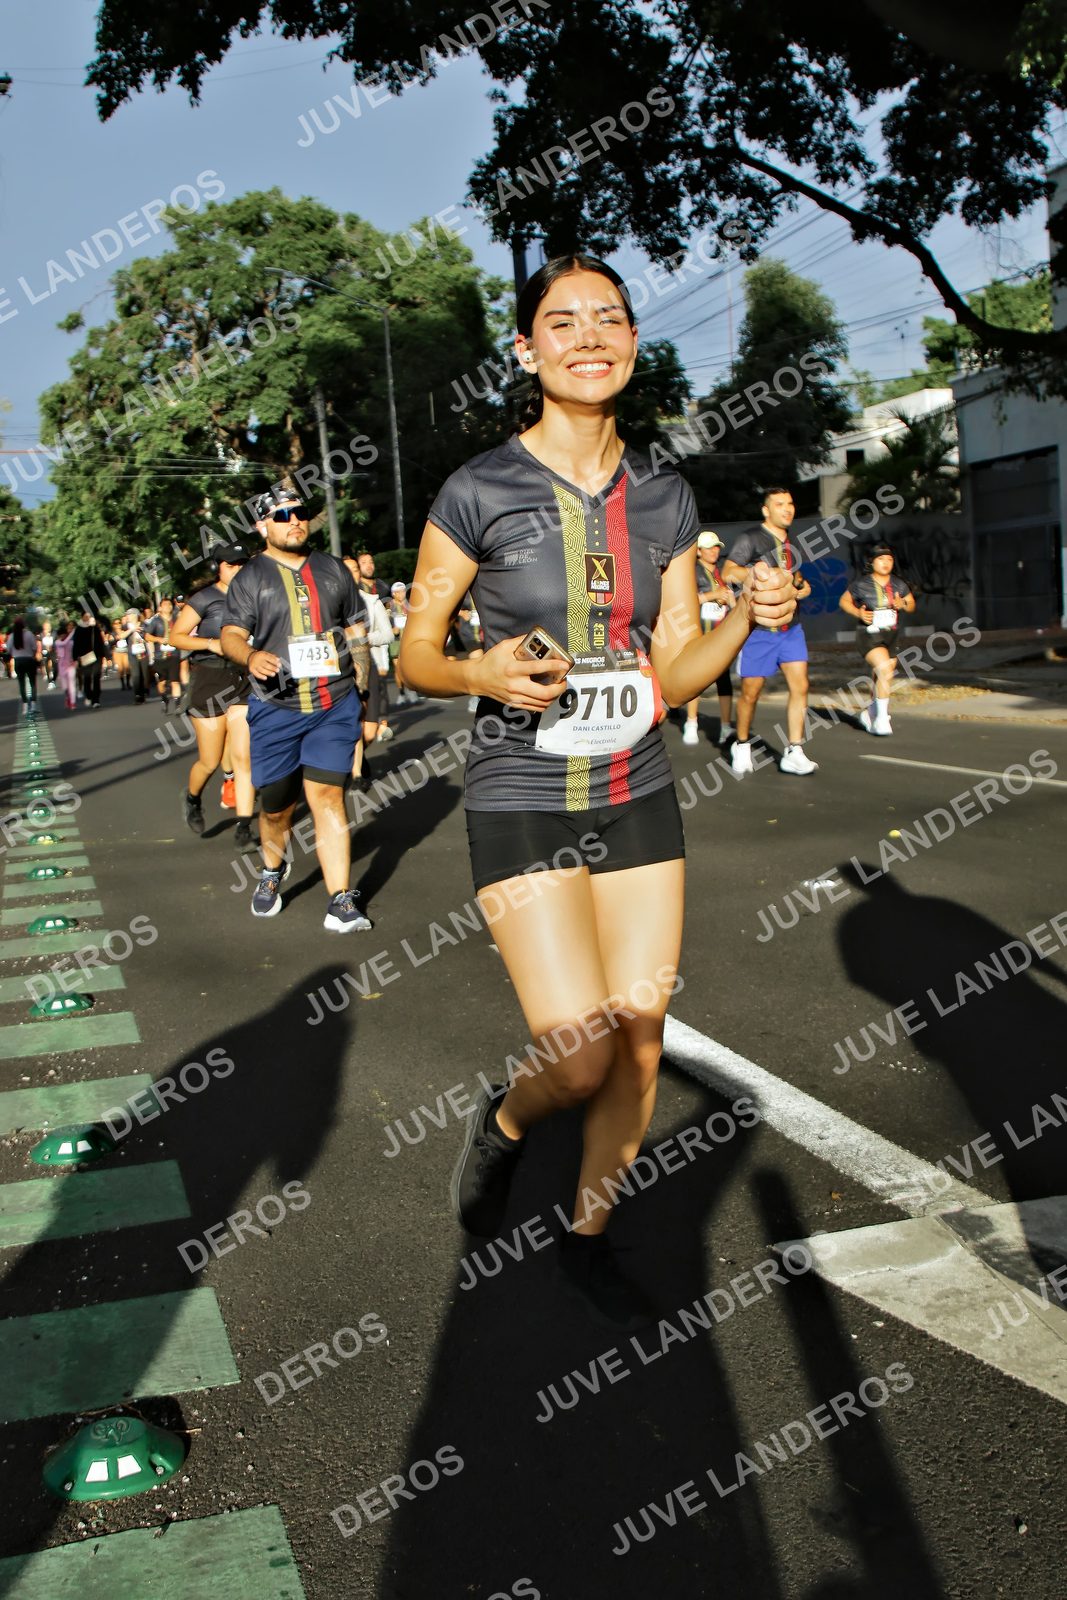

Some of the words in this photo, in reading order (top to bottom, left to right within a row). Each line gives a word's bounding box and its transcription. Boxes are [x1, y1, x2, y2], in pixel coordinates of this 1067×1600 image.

[297, 646, 330, 662] 7435
[559, 684, 638, 721] 9710
[591, 724, 621, 732] CASTILLO
